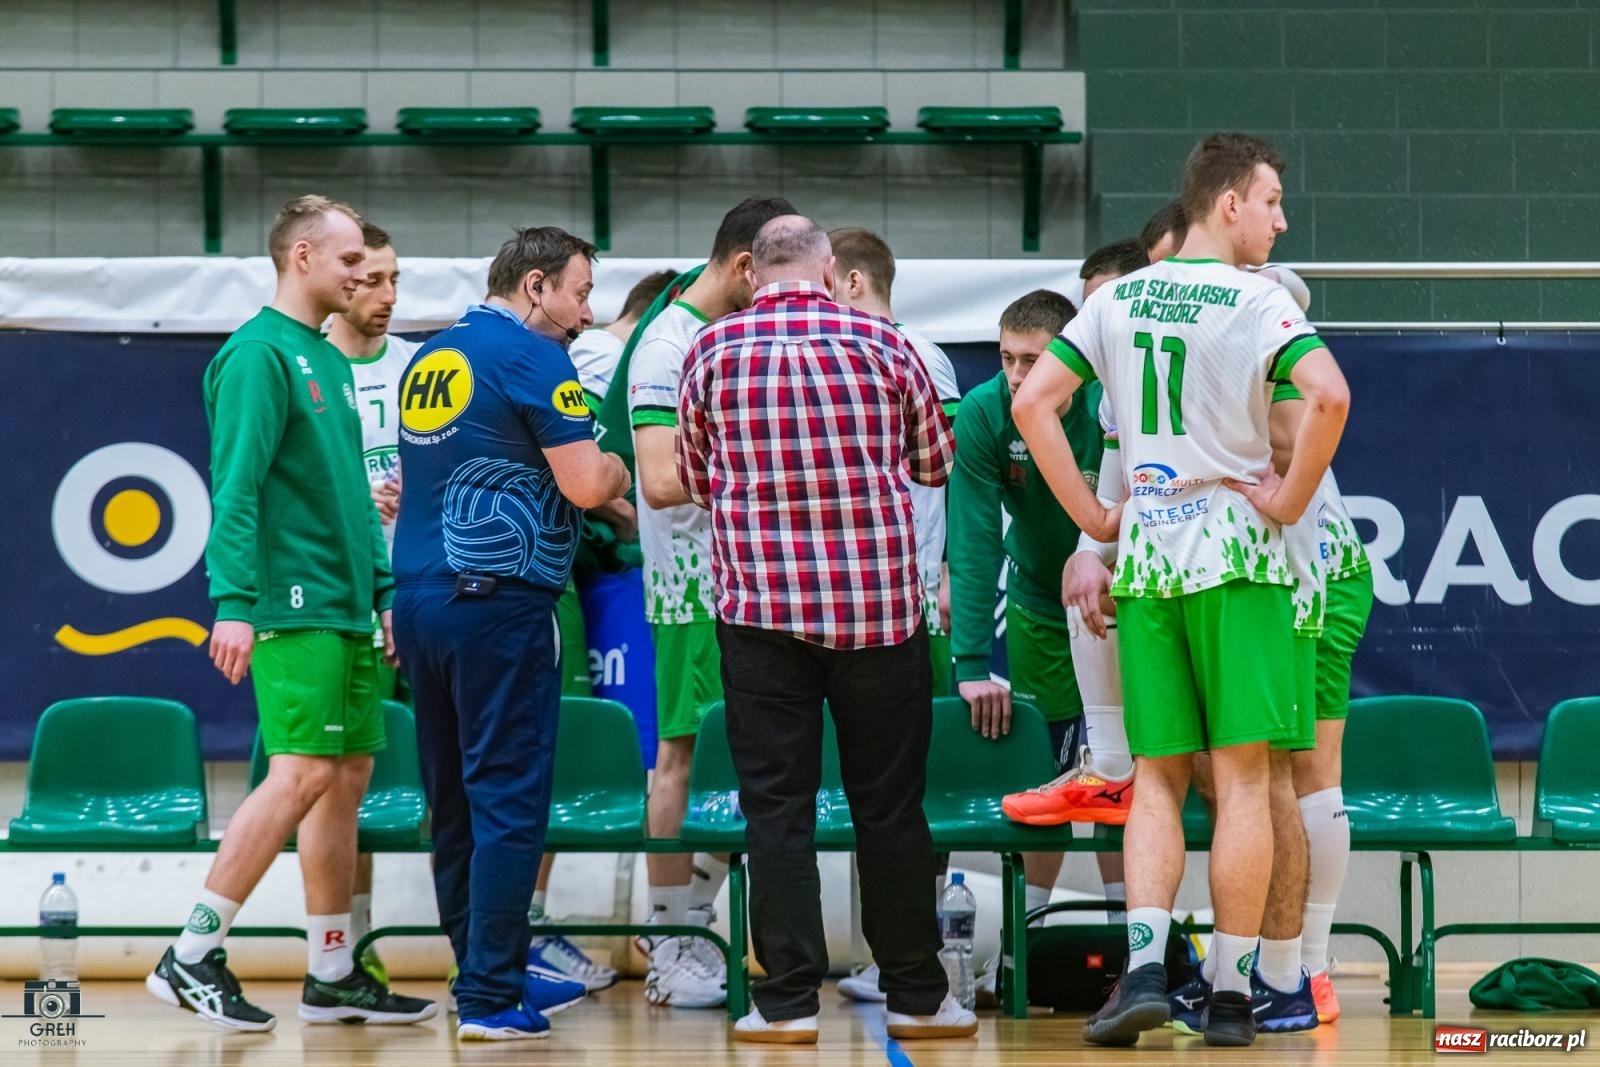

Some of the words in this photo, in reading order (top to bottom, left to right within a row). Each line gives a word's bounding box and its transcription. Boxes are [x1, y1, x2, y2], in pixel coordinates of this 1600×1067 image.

[1147, 279, 1243, 308] SIATKARSKI
[404, 368, 461, 411] HK
[559, 389, 588, 409] HK
[290, 584, 305, 609] 8
[324, 930, 346, 945] R
